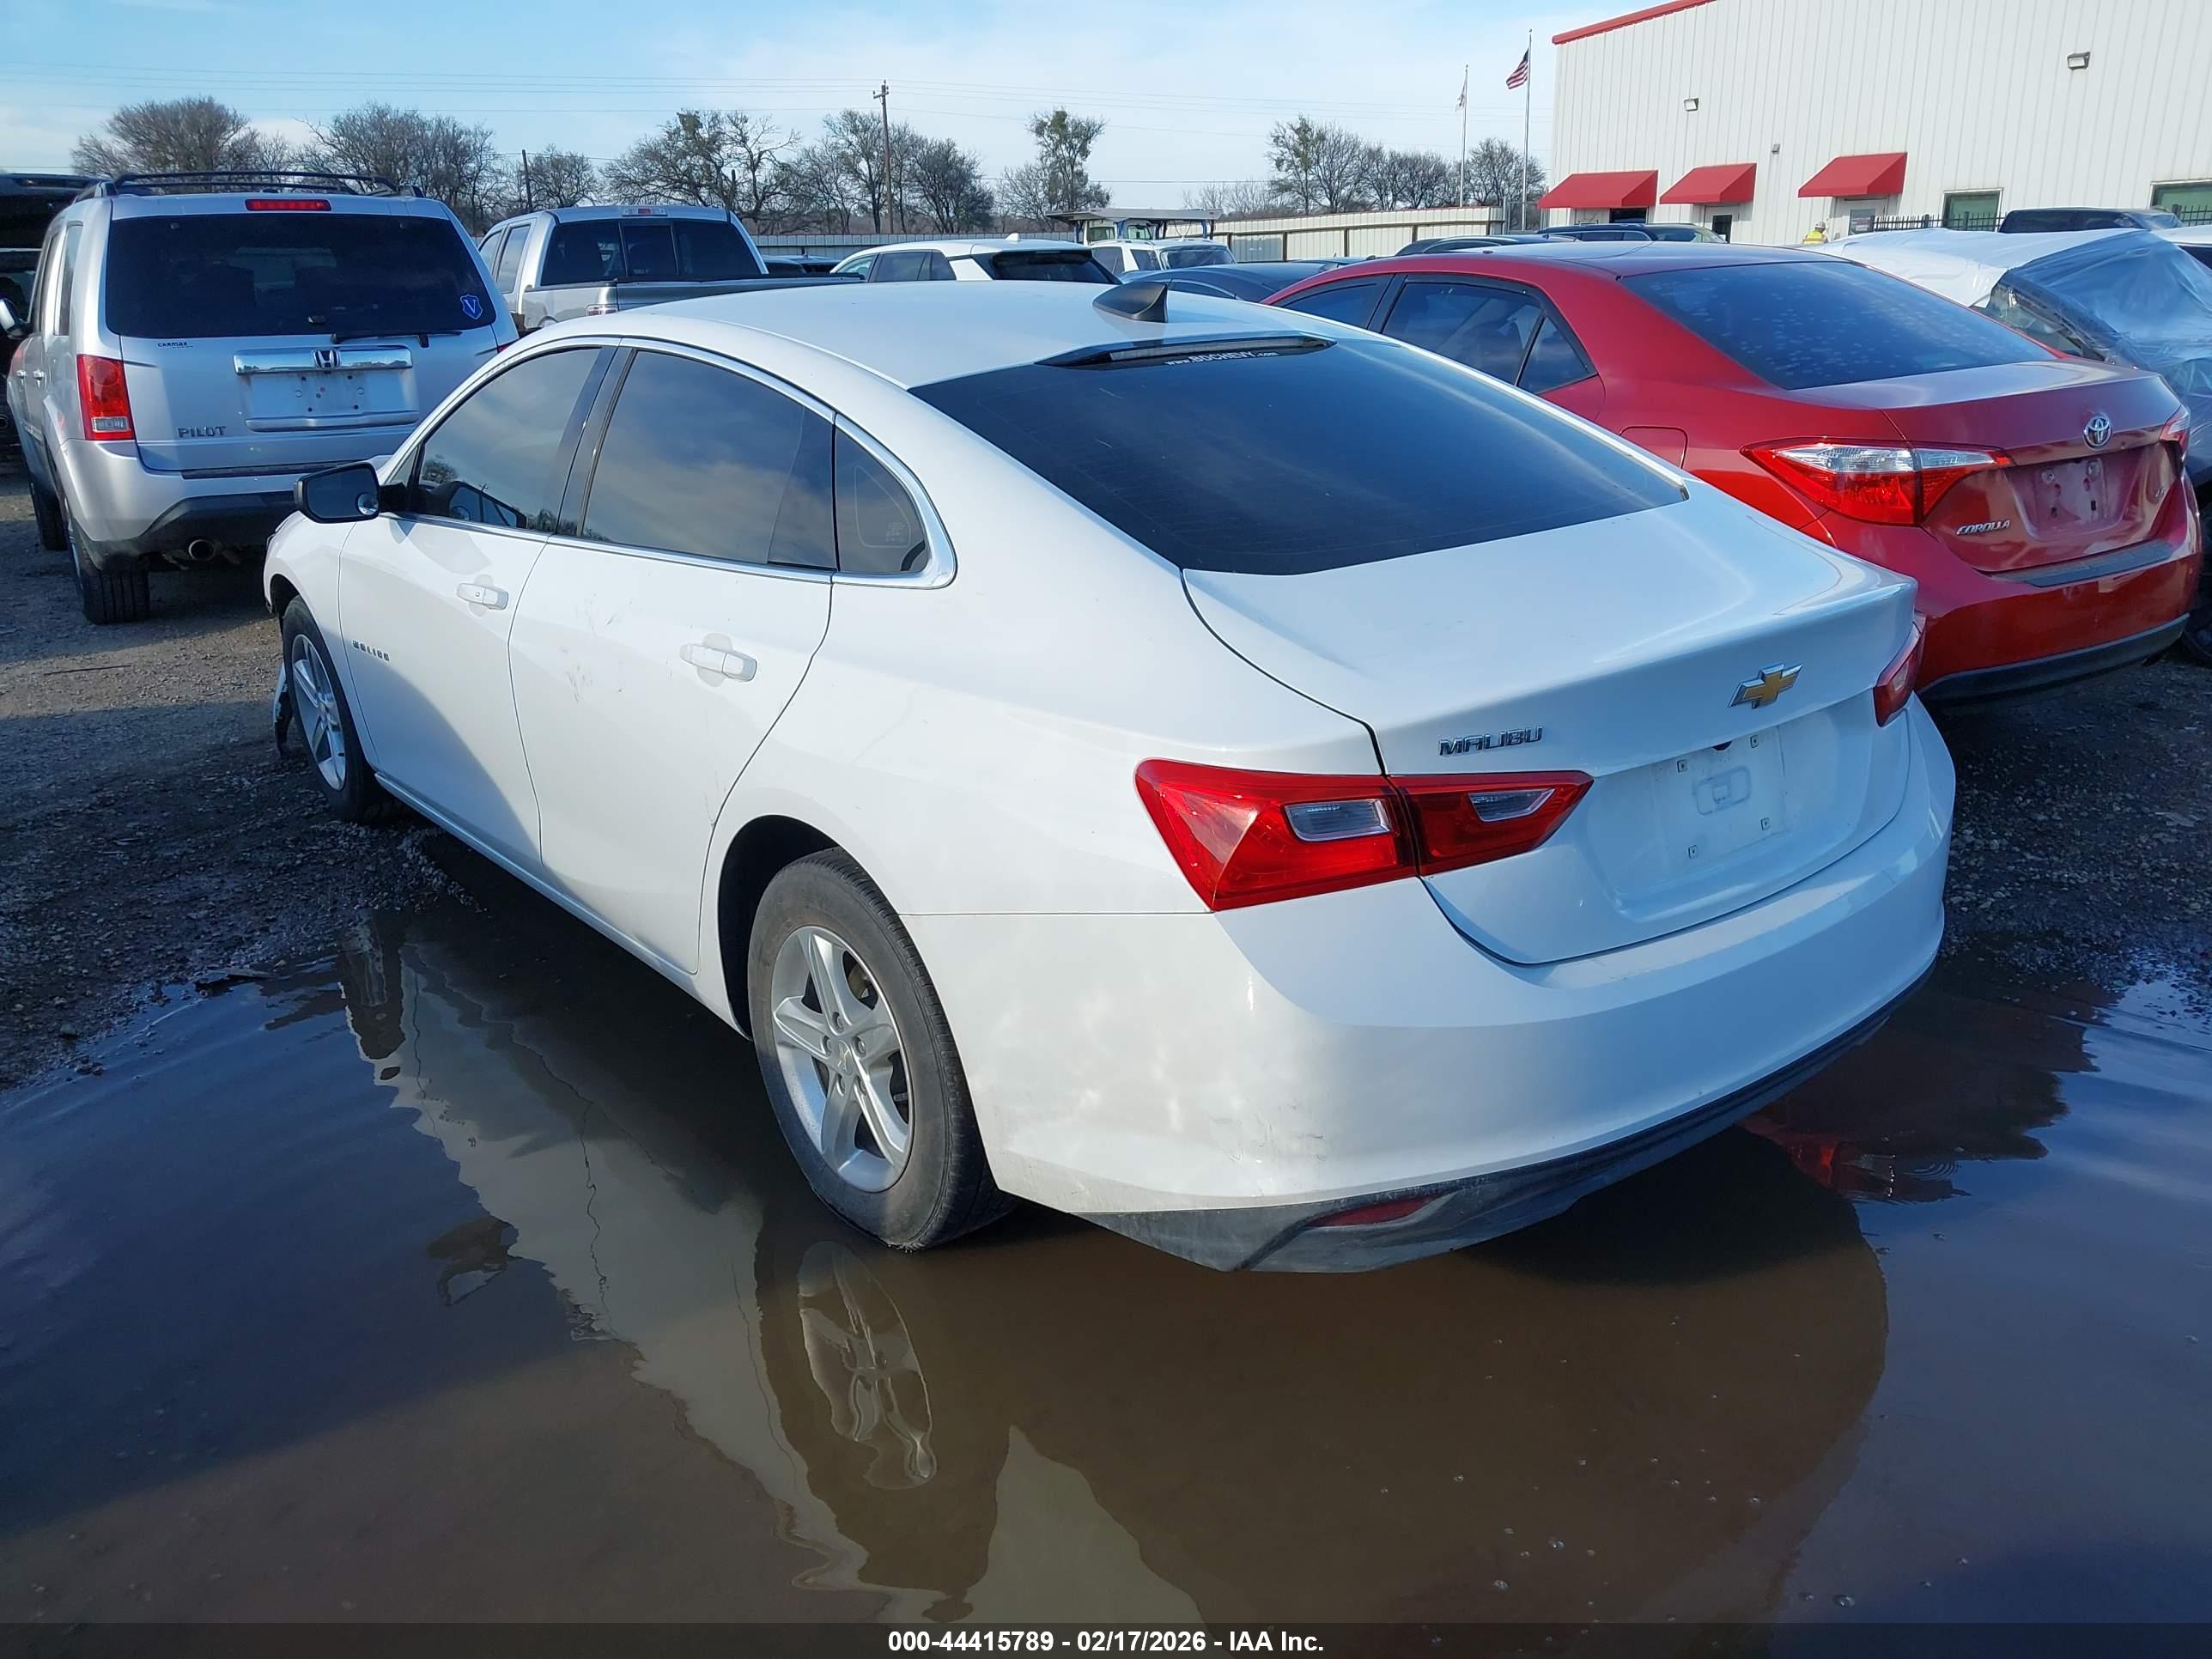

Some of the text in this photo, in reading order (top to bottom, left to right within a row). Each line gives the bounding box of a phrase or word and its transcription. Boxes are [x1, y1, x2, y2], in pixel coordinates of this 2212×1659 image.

[178, 426, 227, 438] PILOT
[1956, 520, 2011, 535] COROLLA
[1439, 726, 1543, 757] MALIBU
